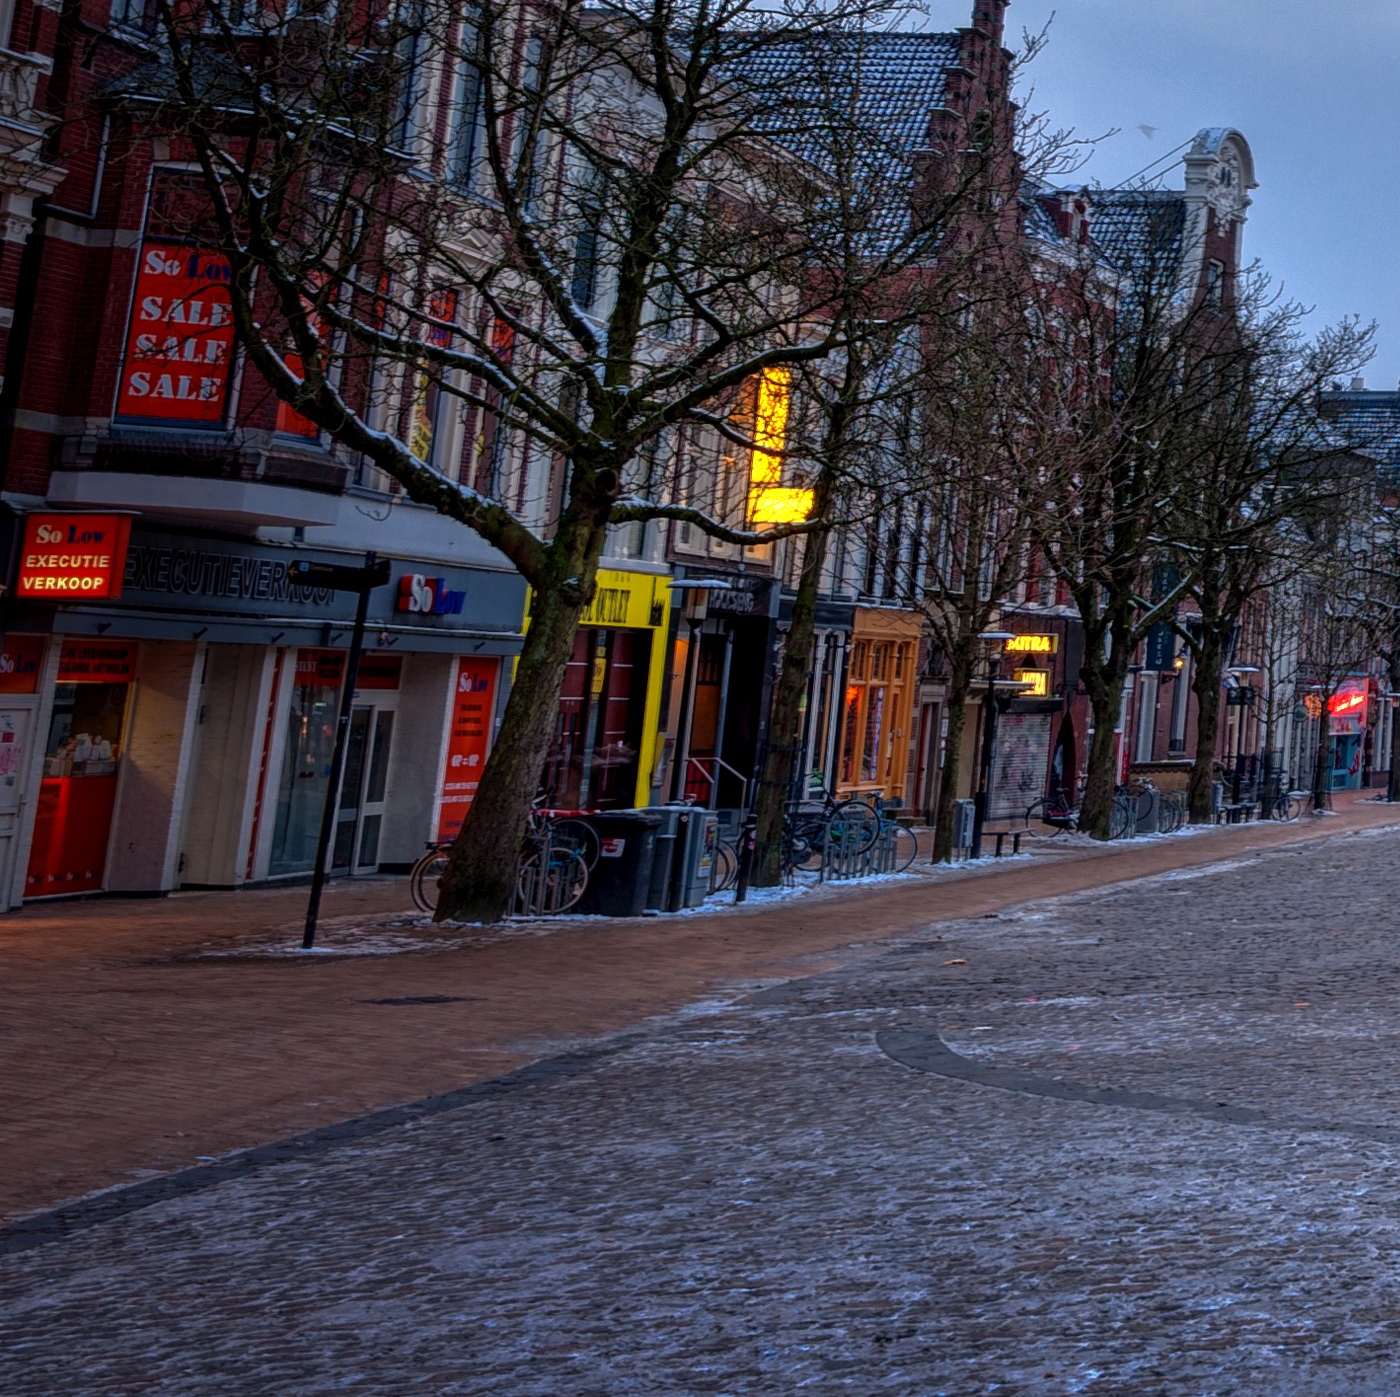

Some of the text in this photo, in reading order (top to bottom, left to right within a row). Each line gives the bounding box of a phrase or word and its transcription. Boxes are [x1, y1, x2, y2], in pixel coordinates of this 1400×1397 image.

[144, 250, 181, 276] So
[139, 296, 233, 326] SALE
[134, 333, 227, 364] SALE
[128, 371, 222, 402] SALE
[36, 524, 62, 544] So
[25, 555, 110, 568] EXECUTIE
[22, 576, 105, 590] VERKOOP
[408, 573, 433, 612] So
